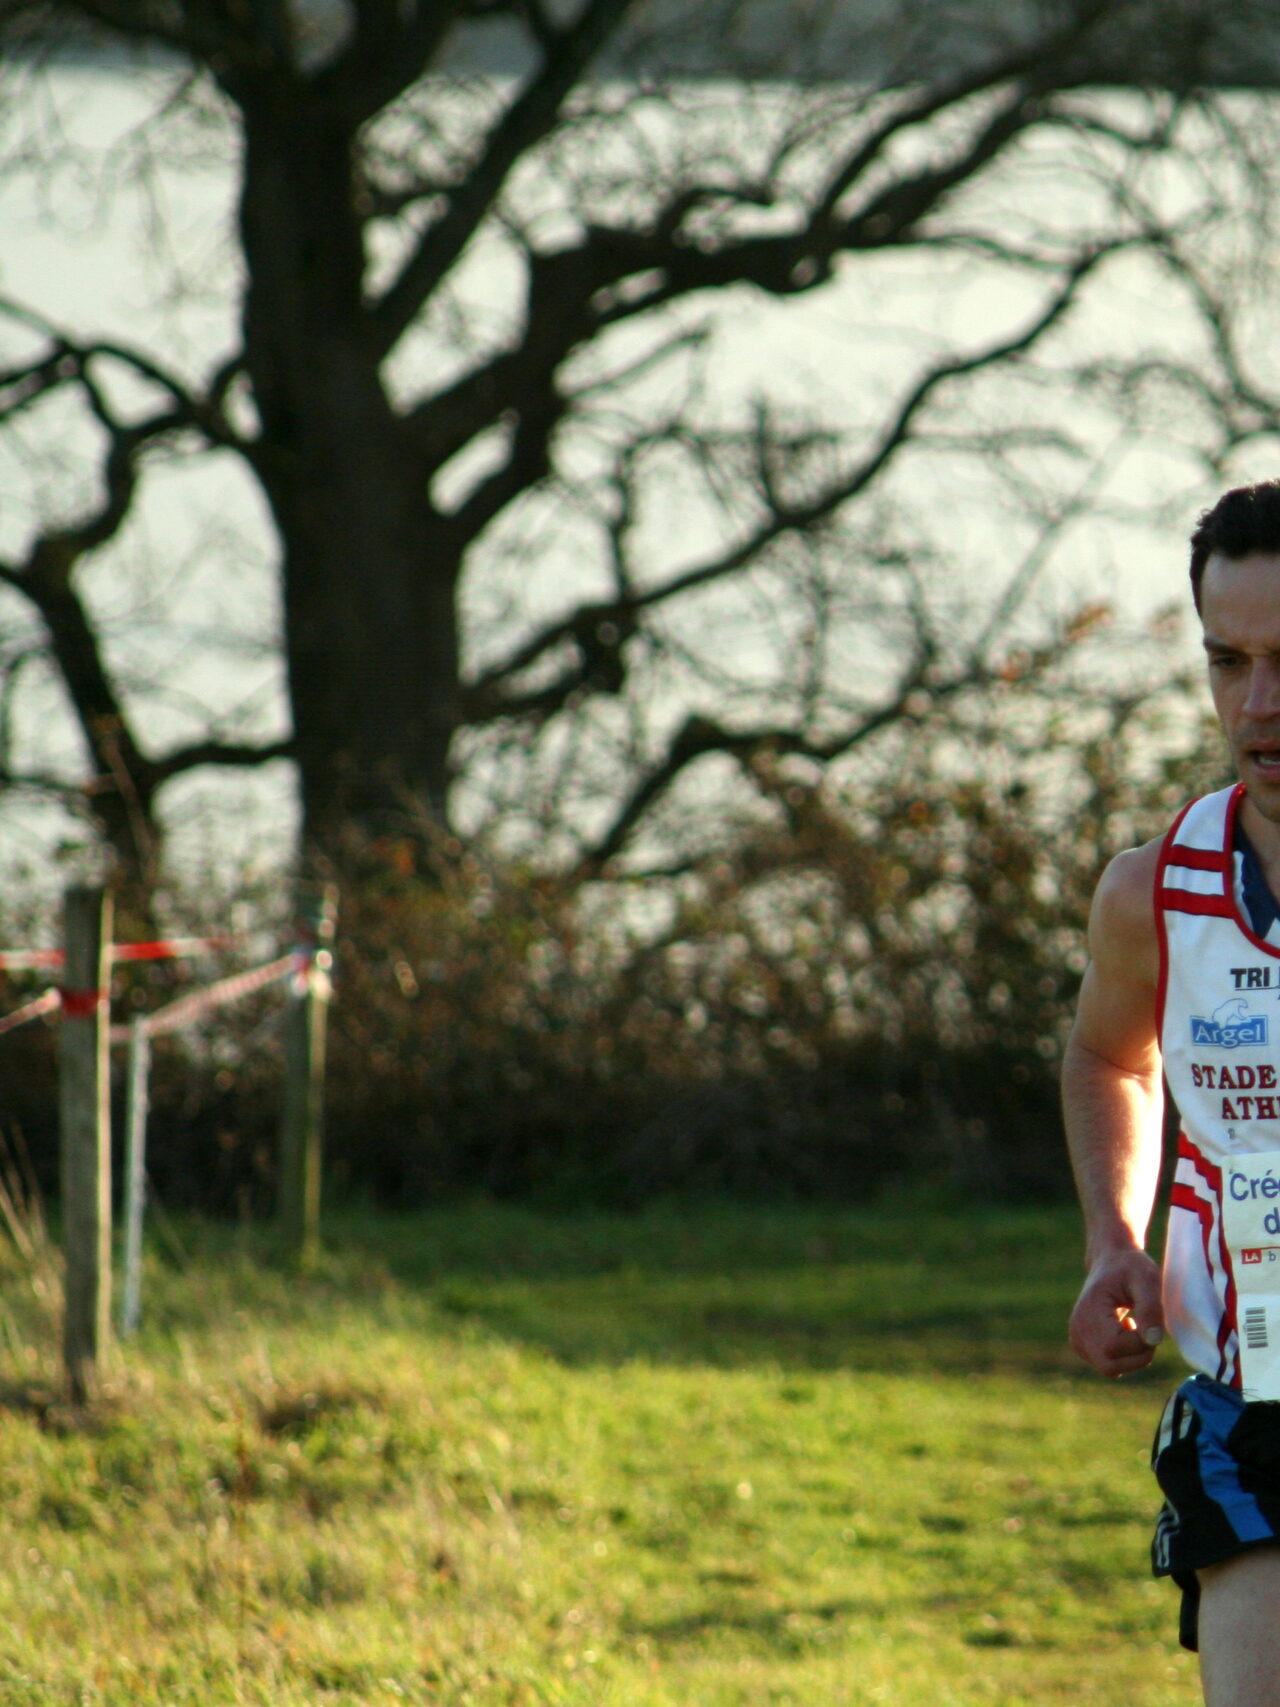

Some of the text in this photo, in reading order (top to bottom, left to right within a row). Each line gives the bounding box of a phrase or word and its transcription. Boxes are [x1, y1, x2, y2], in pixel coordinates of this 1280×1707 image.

[1230, 966, 1270, 988] TRI
[1193, 1024, 1262, 1049] Argel
[1191, 1063, 1277, 1089] STADE
[1244, 1252, 1260, 1263] LA
